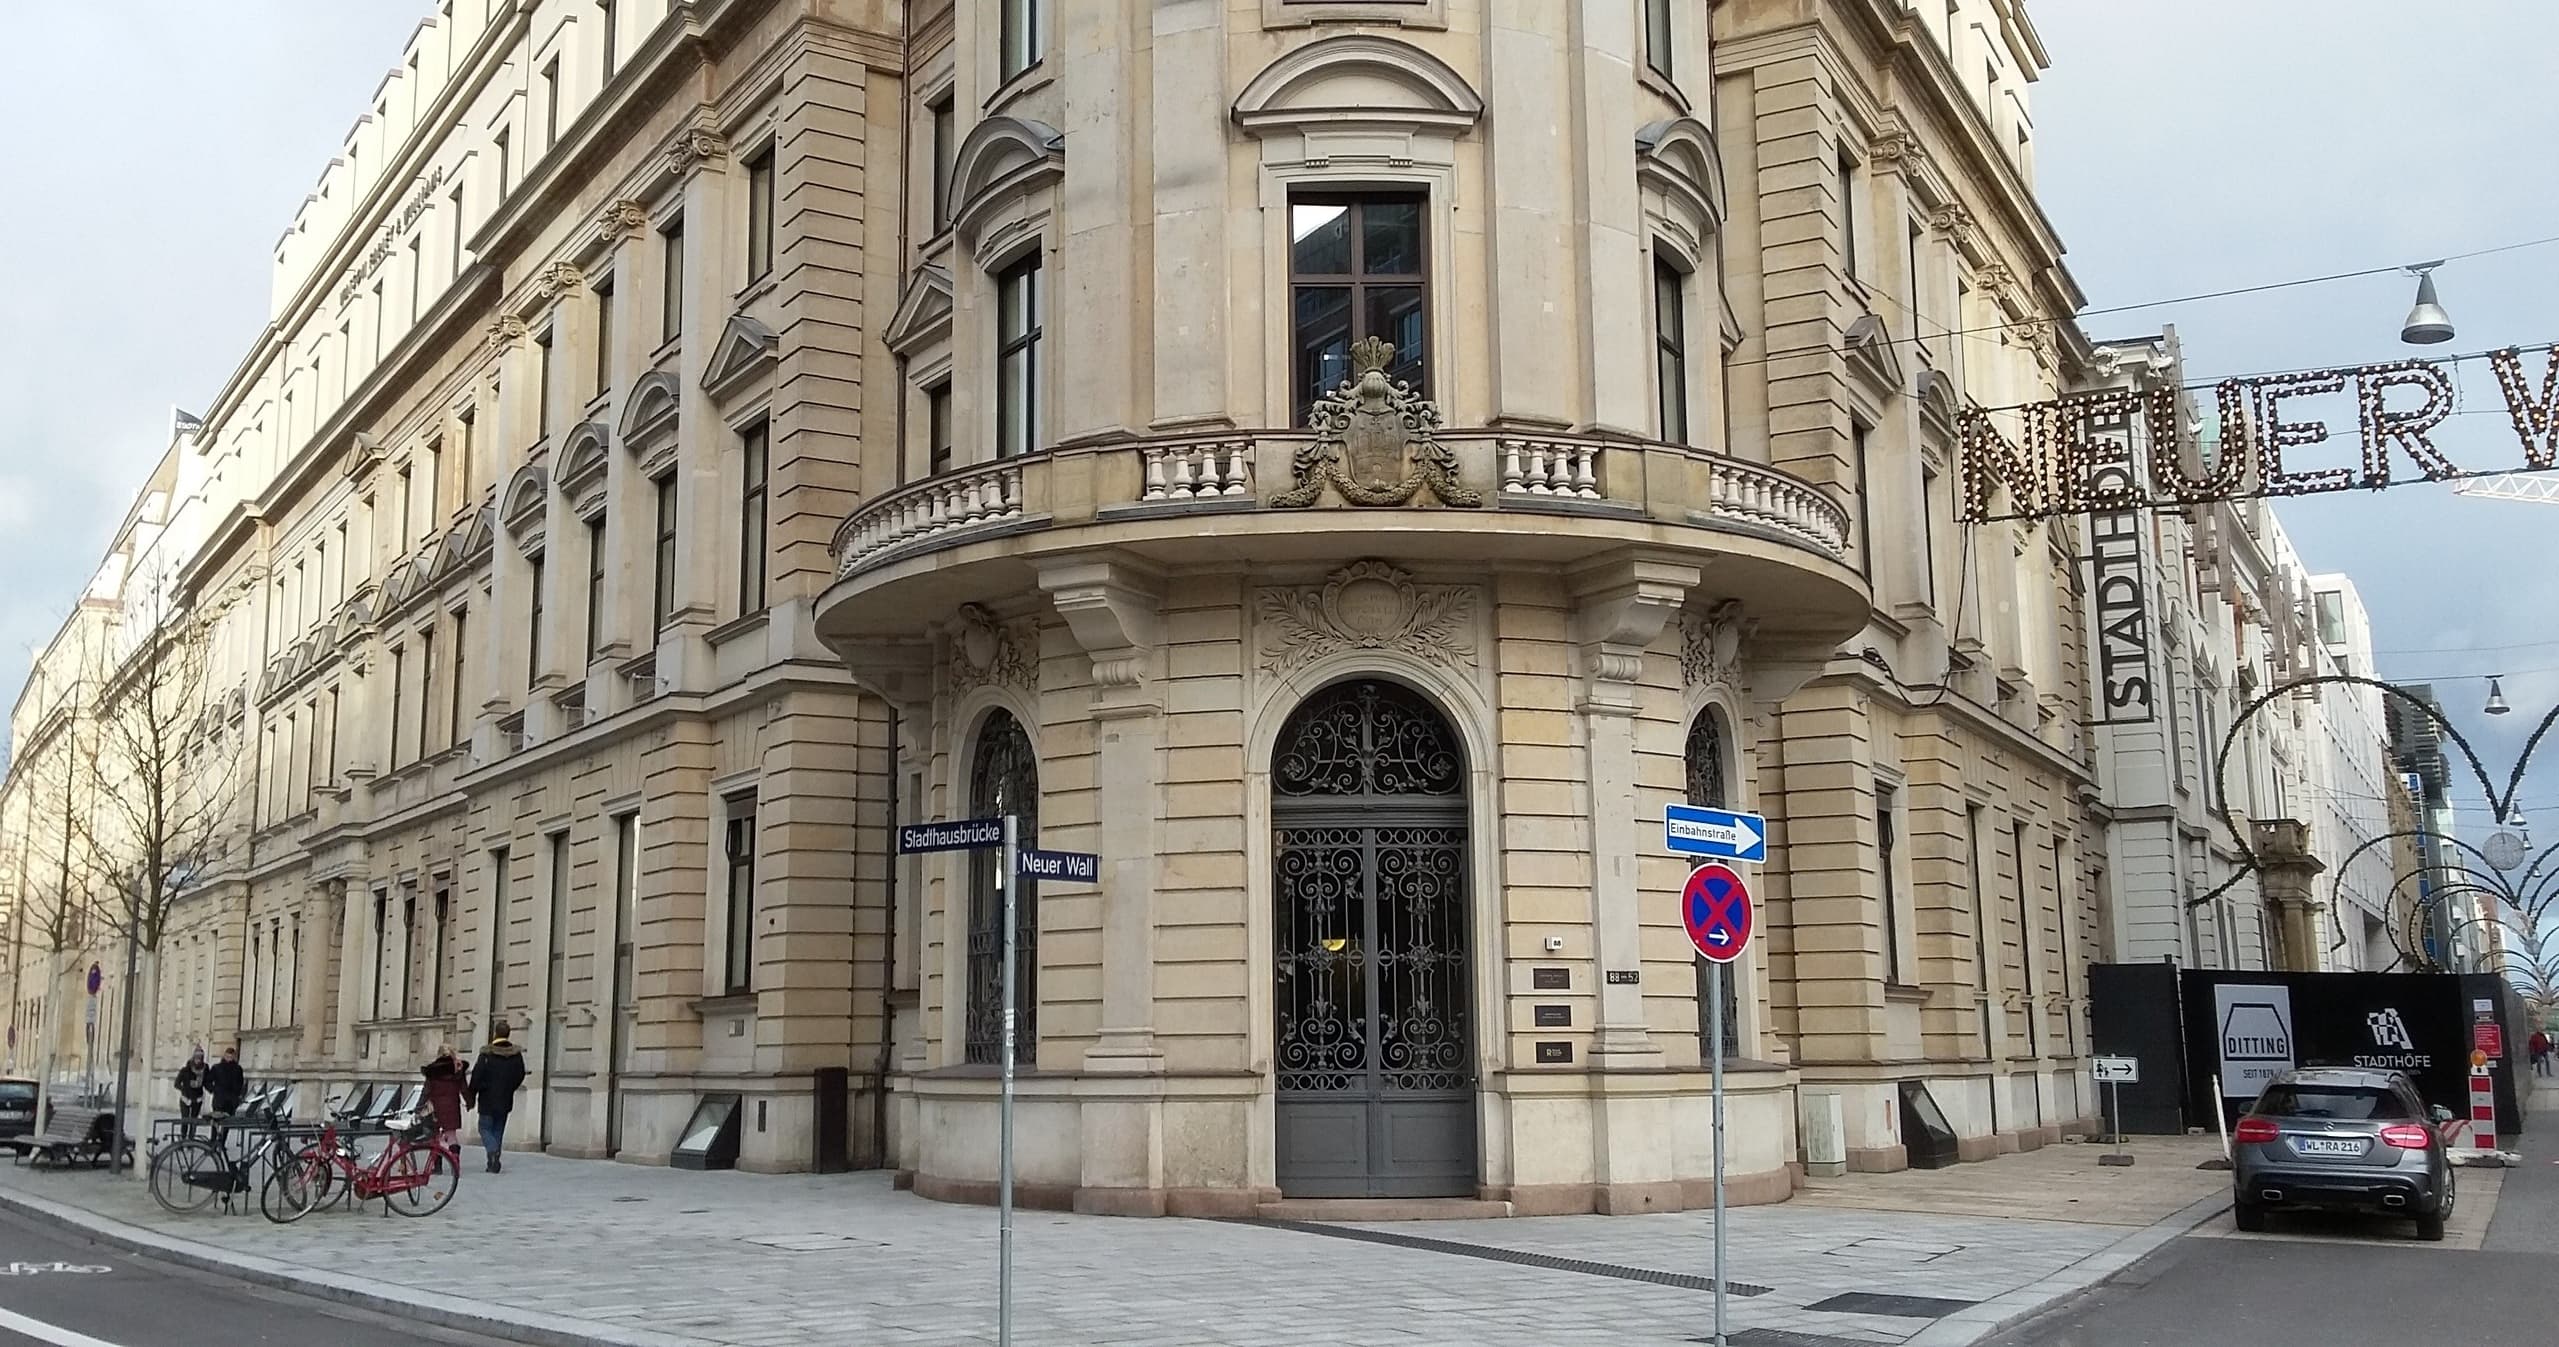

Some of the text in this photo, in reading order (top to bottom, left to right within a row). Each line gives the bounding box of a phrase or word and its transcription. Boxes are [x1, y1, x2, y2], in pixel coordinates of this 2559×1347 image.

[1958, 358, 2458, 524] NEUER
[905, 822, 1000, 849] Stadthausbrücke
[1670, 822, 1736, 841] Einbahnstraße
[1022, 852, 1094, 877] Neuer Wall
[2228, 1037, 2285, 1054] DITTING
[2353, 1053, 2432, 1068] STADTHÖFE
[2243, 1068, 2257, 1079] SEIT
[2326, 1141, 2339, 1151] RA
[2341, 1142, 2360, 1152] 216
